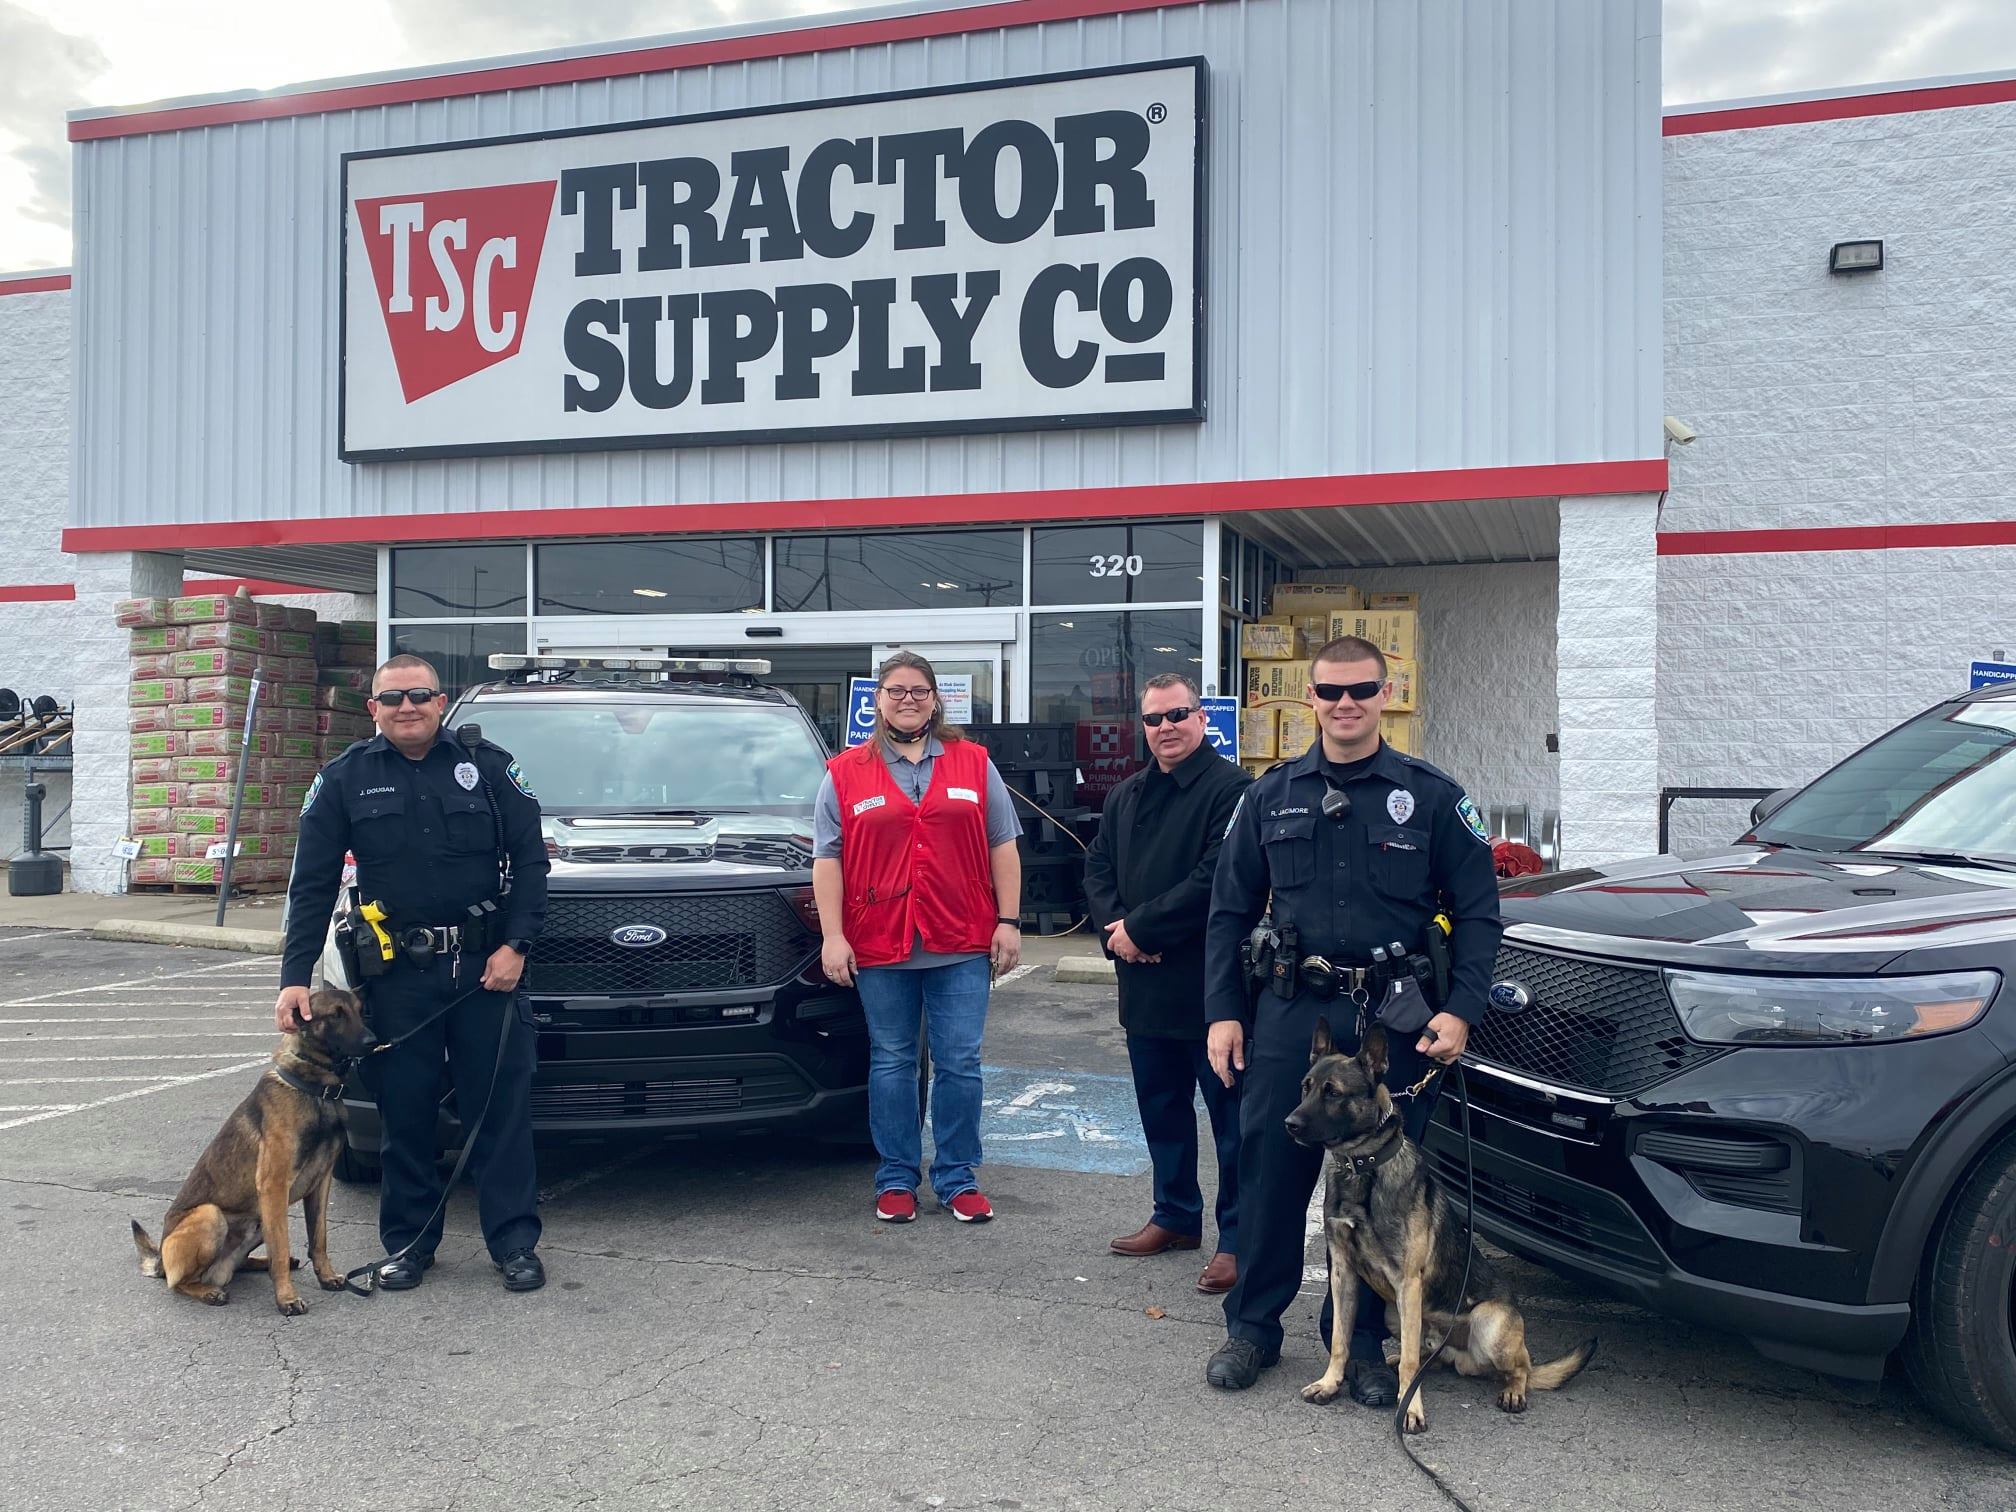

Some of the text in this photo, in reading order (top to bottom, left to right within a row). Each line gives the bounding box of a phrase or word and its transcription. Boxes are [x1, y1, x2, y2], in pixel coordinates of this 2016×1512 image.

[561, 109, 1156, 277] TRACTOR
[380, 202, 517, 353] TSC
[563, 269, 1001, 413] SUPPLY
[1089, 555, 1143, 577] 320
[1973, 669, 2016, 680] HANDICAPP
[850, 731, 874, 740] PARK
[1088, 773, 1122, 783] PURINA
[366, 786, 395, 795] DOUGAN
[623, 929, 653, 942] Ford
[1493, 988, 1517, 1005] Ford
